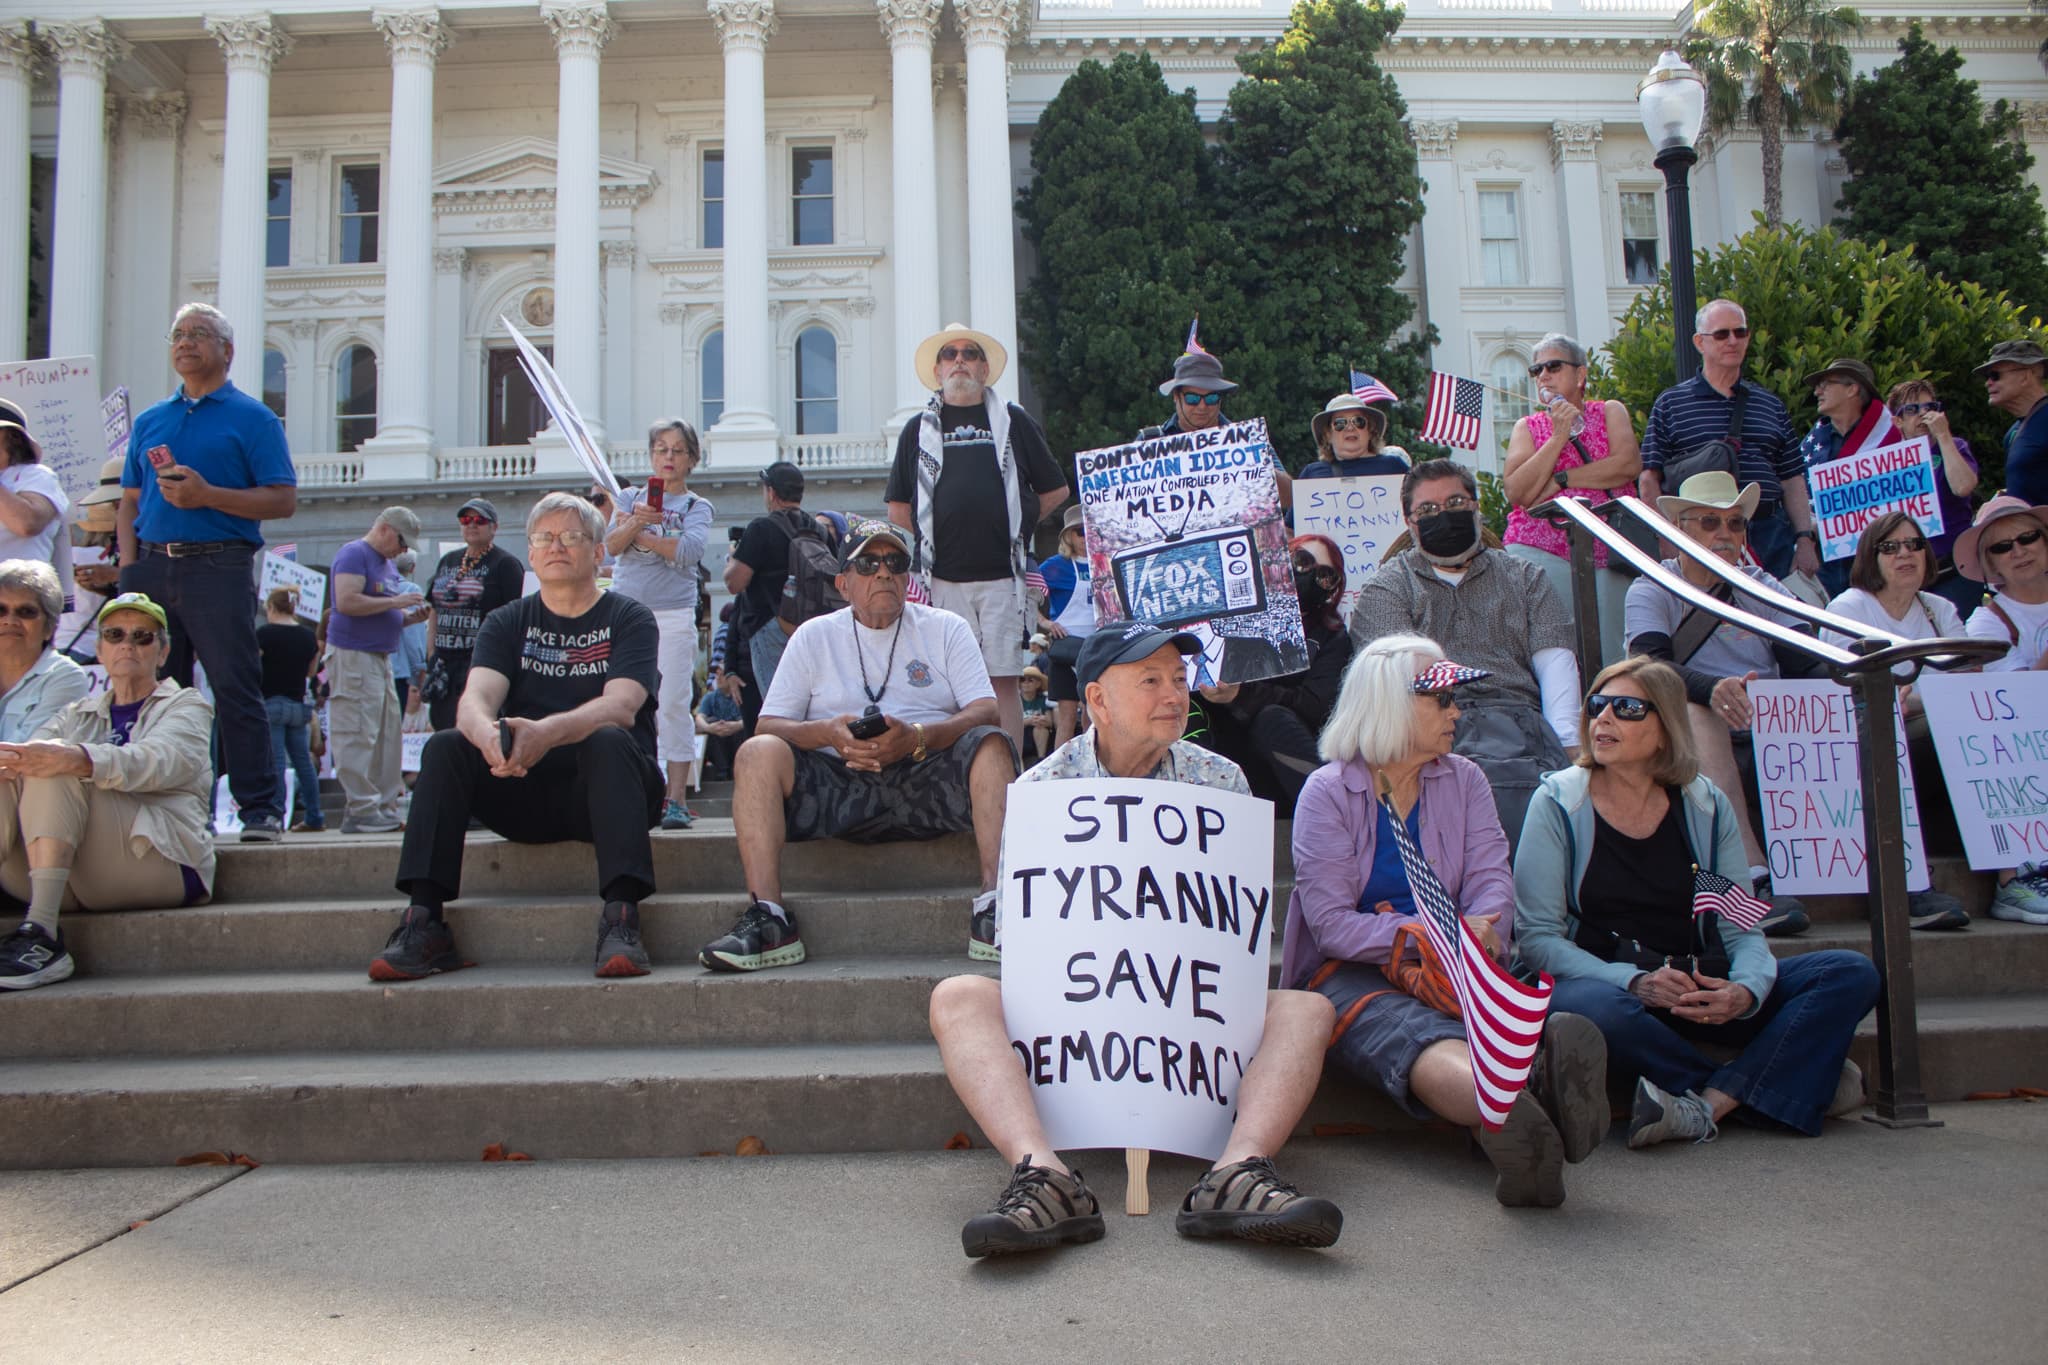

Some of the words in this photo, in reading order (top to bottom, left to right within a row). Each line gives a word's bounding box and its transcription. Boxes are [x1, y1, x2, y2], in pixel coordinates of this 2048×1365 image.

[16, 363, 68, 387] TRUMP
[1195, 430, 1220, 450] BE
[1222, 426, 1251, 446] AN
[1082, 456, 1182, 493] AMERICAN
[1189, 443, 1267, 473] IDIOT
[1814, 464, 1853, 491] THIS
[1855, 458, 1872, 481] IS
[1873, 443, 1922, 475] WHAT
[1084, 488, 1111, 506] ONE
[1223, 472, 1240, 485] BY
[1243, 467, 1267, 481] THE
[1127, 489, 1215, 520] MEDIA
[1310, 486, 1388, 510] STOP
[1819, 468, 1925, 515] DEMOCRACY
[1304, 510, 1400, 532] TYRANNY
[1822, 505, 1880, 540] LOOKS
[1148, 556, 1207, 593] FOX
[521, 656, 567, 678] WONG
[1756, 694, 1839, 734] PARADE
[1970, 689, 2019, 721] U.S.
[1762, 741, 1907, 782] GRIFTR
[1958, 734, 1988, 767] IS
[1993, 733, 2015, 764] A
[1763, 790, 1797, 831] IS
[1804, 790, 1822, 829] A
[1966, 775, 2048, 810] TANKS
[1064, 795, 1225, 854] STOP
[1768, 839, 1802, 879] OF
[1012, 865, 1269, 955] TYRANNY
[1064, 949, 1225, 1025] SAVE
